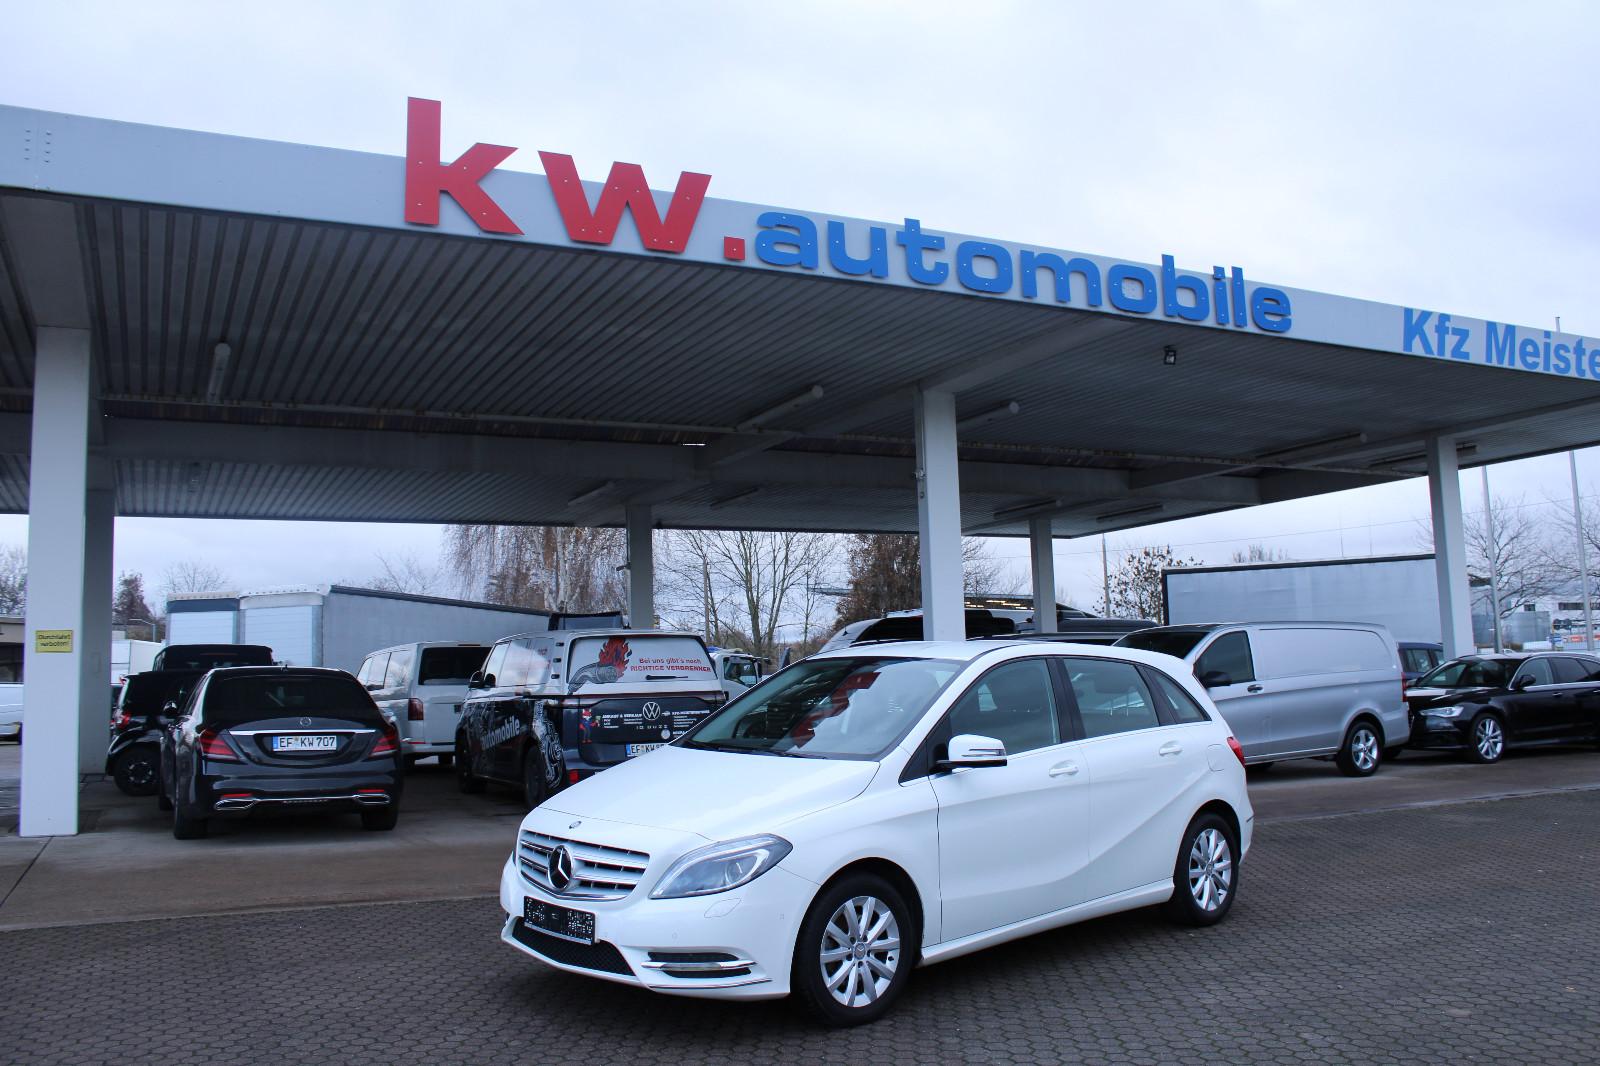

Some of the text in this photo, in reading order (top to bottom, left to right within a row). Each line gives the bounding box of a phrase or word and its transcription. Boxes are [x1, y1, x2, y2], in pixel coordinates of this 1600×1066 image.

[1402, 307, 1470, 361] Kfz
[280, 737, 335, 748] EF KW 707
